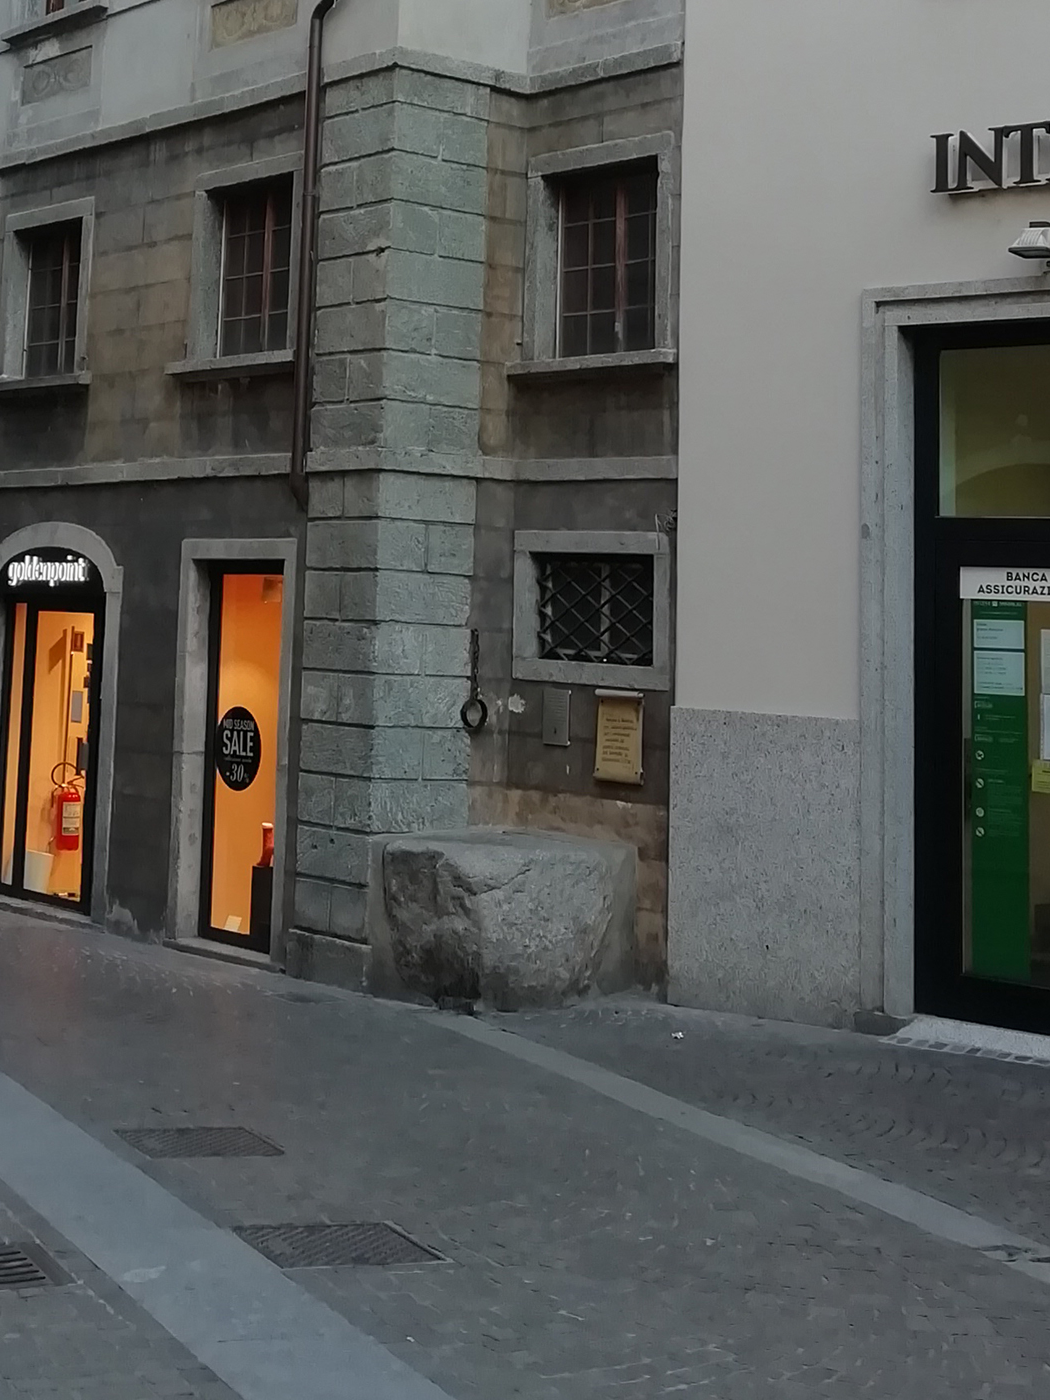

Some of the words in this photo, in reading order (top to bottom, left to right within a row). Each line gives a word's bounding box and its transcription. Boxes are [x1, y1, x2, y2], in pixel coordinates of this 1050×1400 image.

[930, 121, 1050, 193] INT
[8, 555, 88, 587] goldenpoint
[1006, 571, 1048, 583] BANCA
[977, 584, 1050, 596] ASSICURAZI
[234, 719, 254, 731] SEASON
[222, 730, 254, 756] SALE
